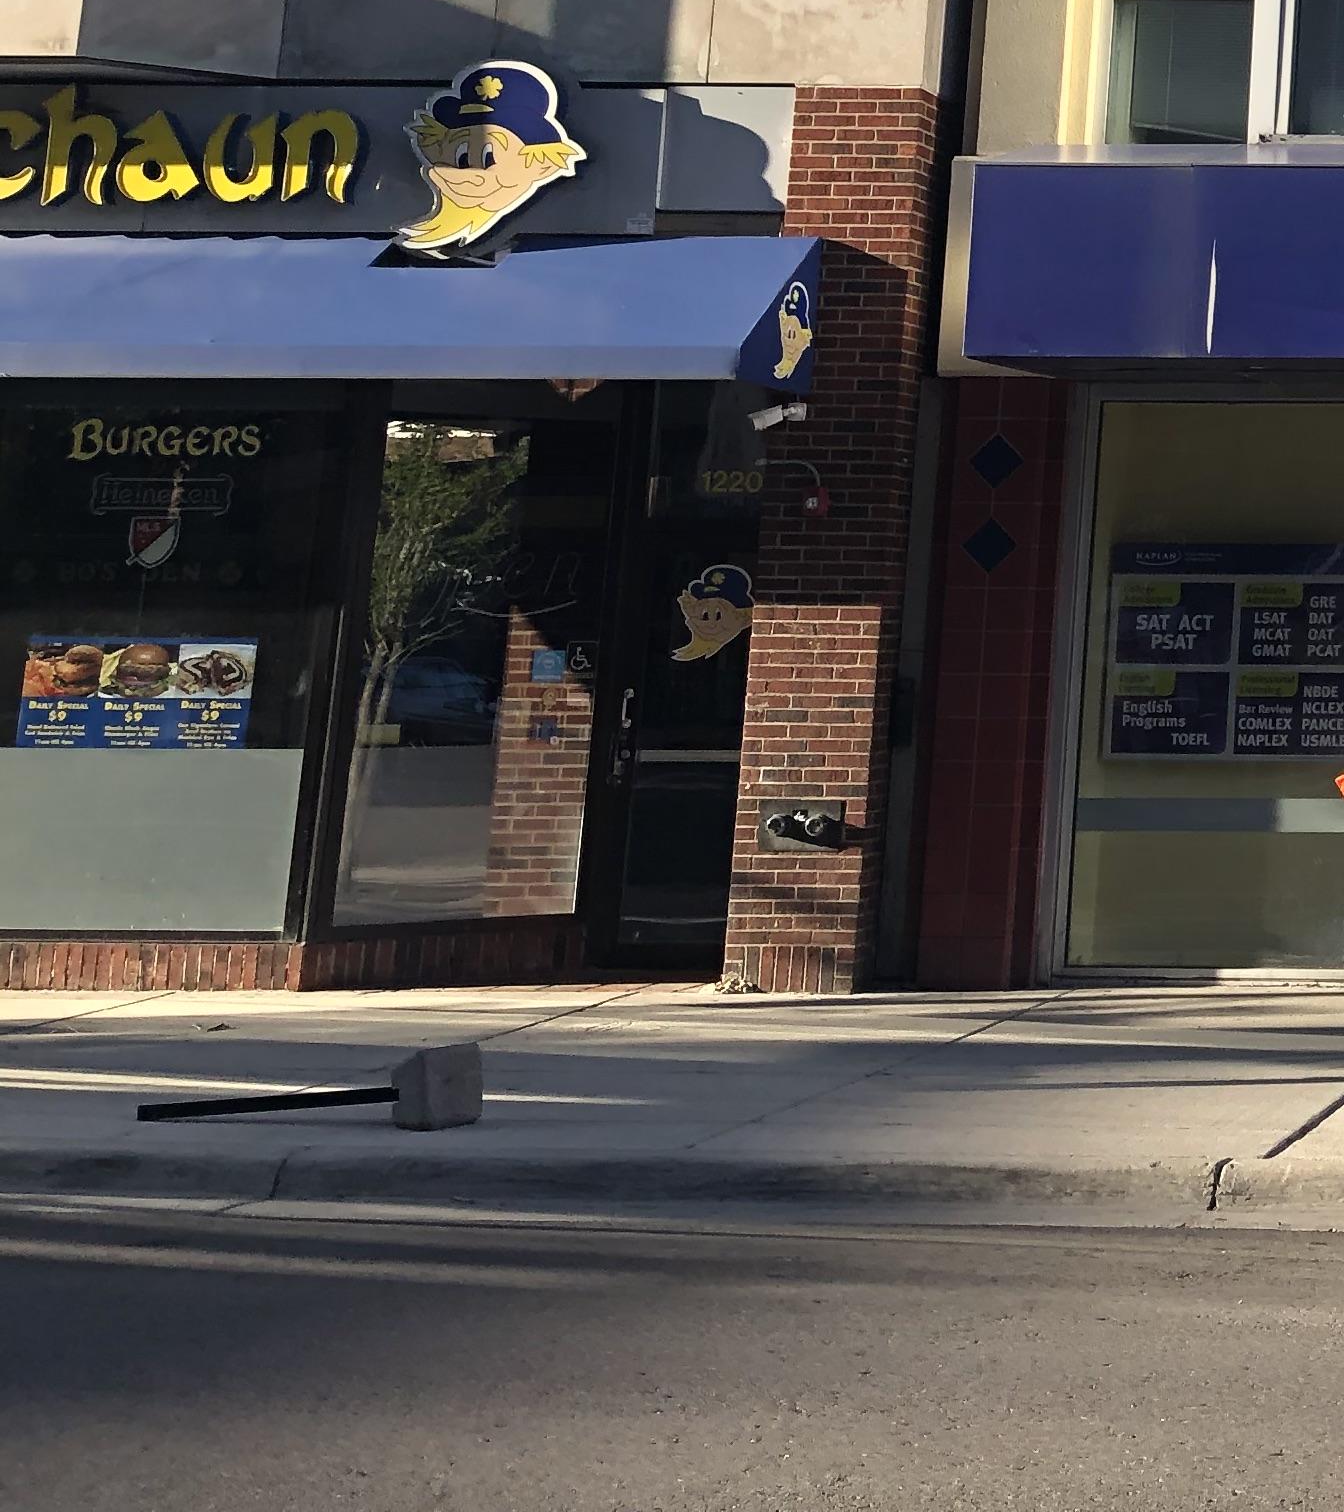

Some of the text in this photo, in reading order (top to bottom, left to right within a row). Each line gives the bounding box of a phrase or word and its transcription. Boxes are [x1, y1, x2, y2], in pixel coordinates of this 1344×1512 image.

[701, 470, 764, 493] 1220
[1309, 595, 1337, 609] GRE
[1135, 614, 1215, 631] SAT ACT
[1254, 612, 1287, 624] LSAT
[1308, 612, 1335, 624] DAT
[1253, 628, 1292, 640] MCAT
[1151, 633, 1198, 650] PSAT
[1252, 644, 1293, 657] GMAT
[1306, 644, 1342, 657] PCAT
[1303, 685, 1339, 698] NBDE
[1122, 700, 1173, 716] English
[1301, 702, 1344, 714] NCLEX
[1122, 715, 1187, 730] Programs
[1238, 717, 1293, 730] COMLEX
[1301, 718, 1344, 731] PANCE
[1171, 733, 1210, 746] TOEFL
[1237, 734, 1289, 746] NAPLEX
